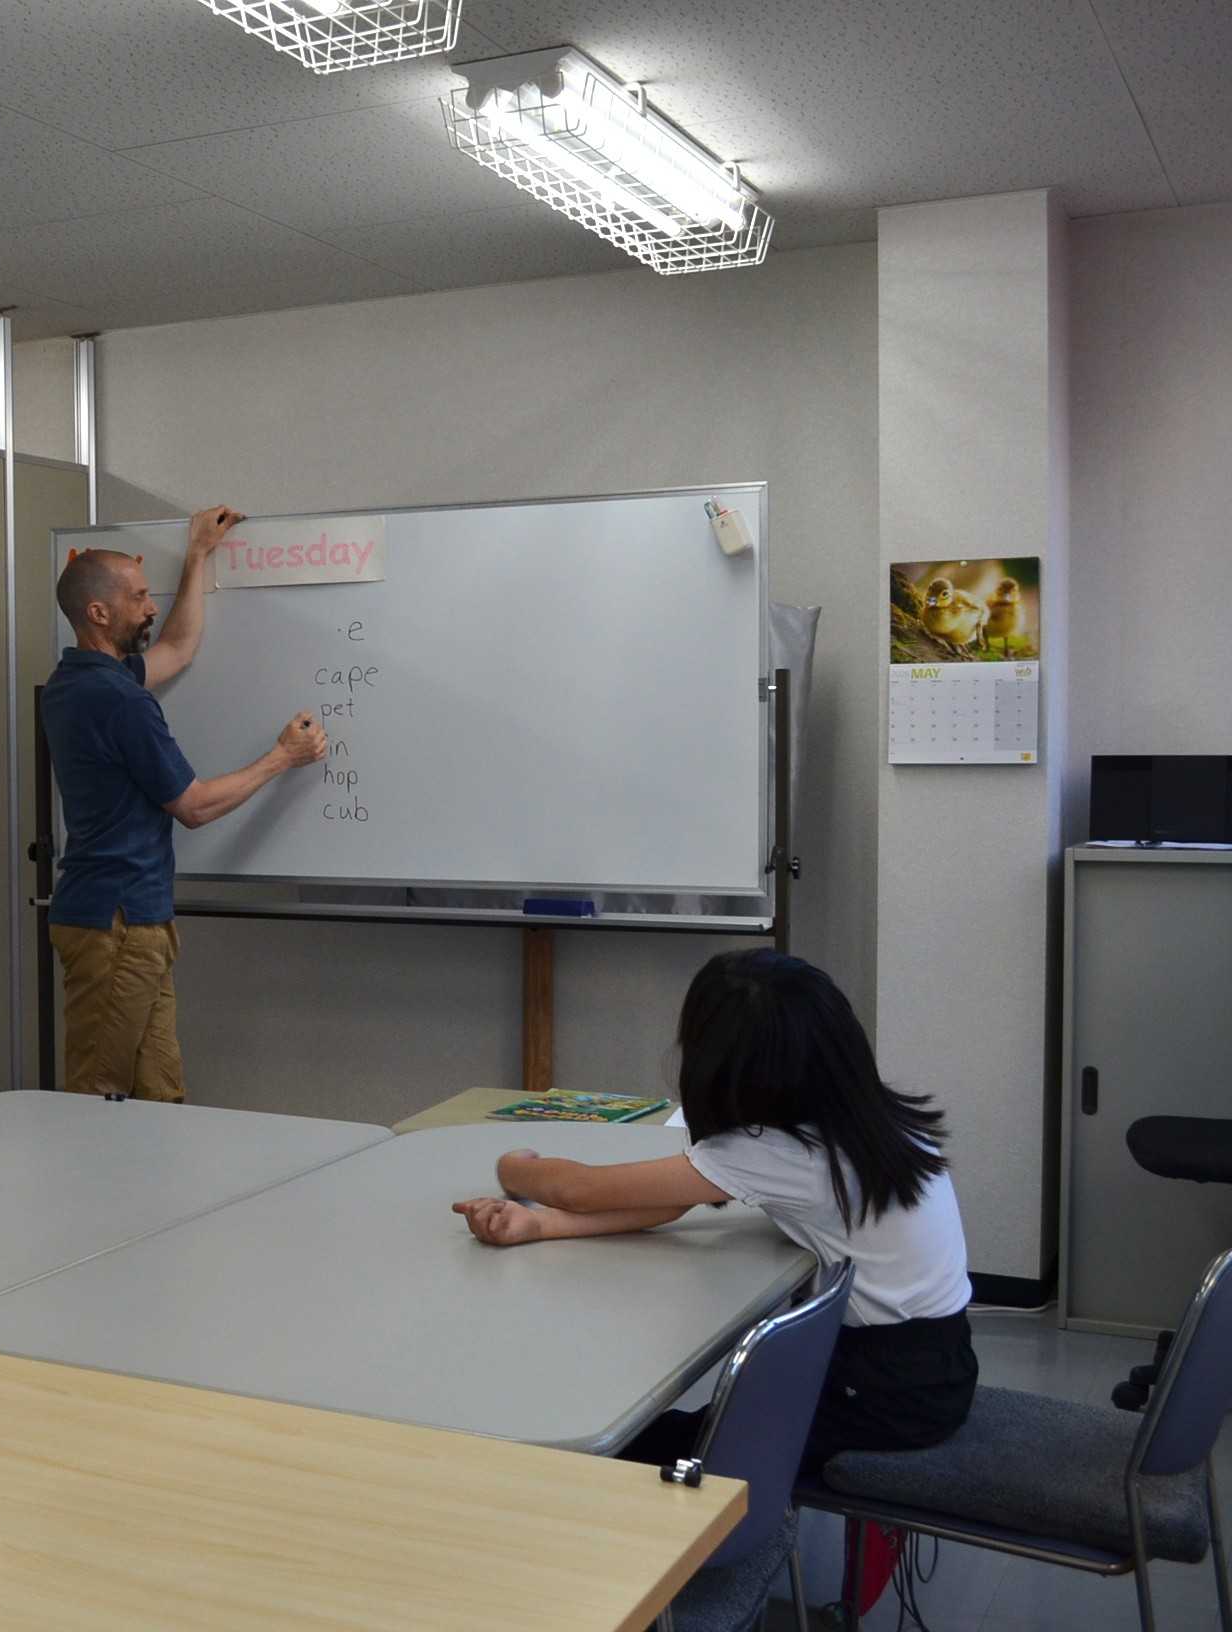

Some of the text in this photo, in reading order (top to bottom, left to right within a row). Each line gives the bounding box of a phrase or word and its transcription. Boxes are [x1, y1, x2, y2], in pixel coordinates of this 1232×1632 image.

[220, 533, 375, 574] Tuesday
[314, 665, 379, 693] cape
[911, 667, 941, 679] MAY
[320, 698, 355, 730] pet
[323, 764, 359, 793] hop
[322, 795, 369, 822] cub
